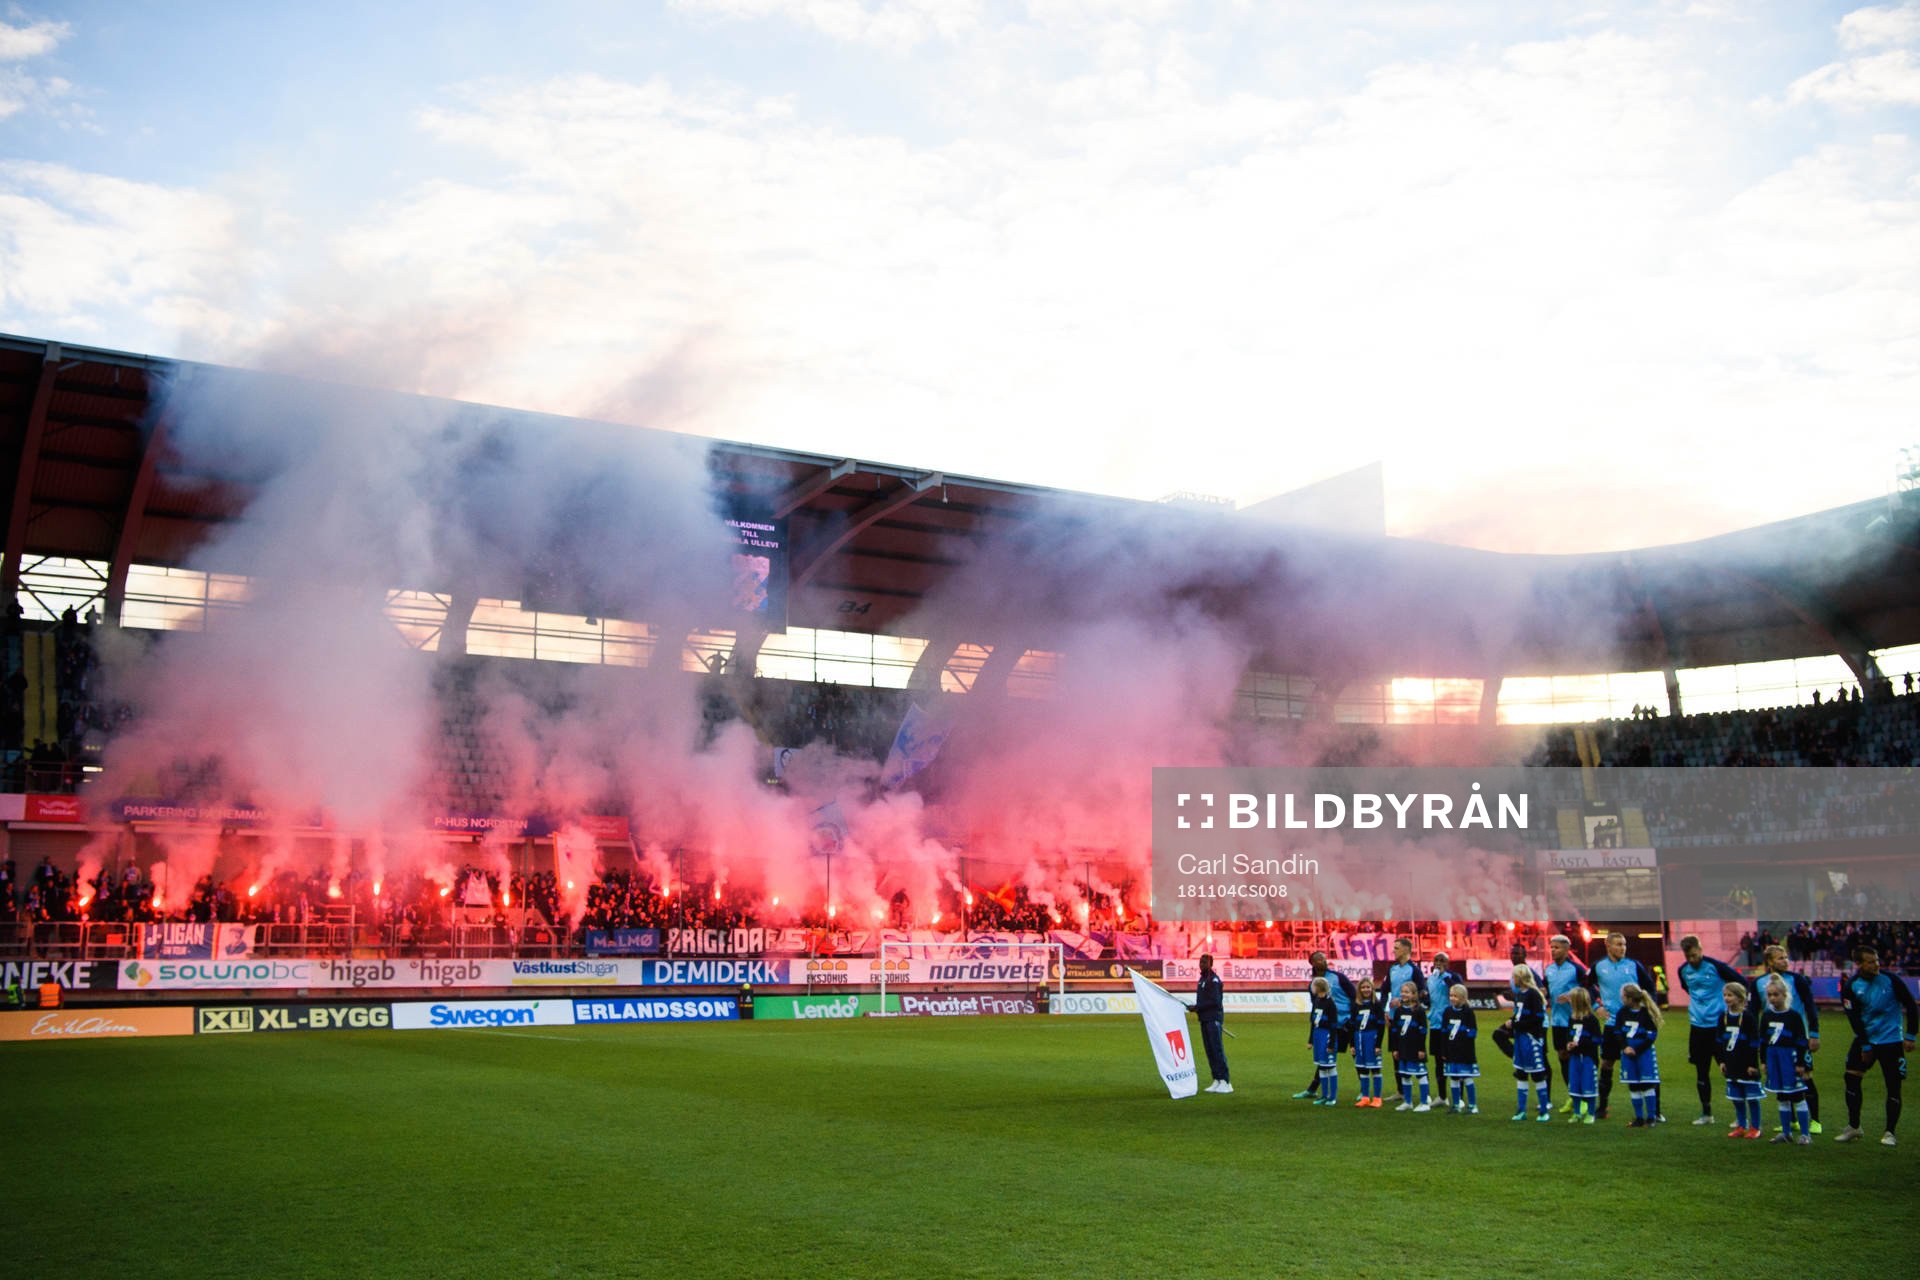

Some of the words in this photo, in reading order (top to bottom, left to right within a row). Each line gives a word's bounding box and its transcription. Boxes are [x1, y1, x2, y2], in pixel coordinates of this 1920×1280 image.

[724, 519, 775, 532] VÄLKOMMEN
[741, 529, 759, 538] TILL
[751, 540, 779, 549] ULLEVI
[124, 805, 195, 818] PARKERING
[435, 816, 468, 828] P-HUS
[1550, 857, 1590, 868] RASTA
[1602, 856, 1642, 867] RASTA
[147, 923, 205, 945] J-LIGAN
[330, 959, 395, 987] higab
[421, 959, 482, 986] higab
[655, 960, 780, 984] DEMIDEKK
[929, 961, 1045, 980] nordsvets
[1233, 964, 1272, 980] Botrygg
[576, 1002, 730, 1021] ERLANDSSON
[793, 999, 854, 1019] Lendo
[903, 996, 979, 1015] Prioritet
[981, 996, 1036, 1014] Finans
[258, 1007, 389, 1029] XL-BYGG
[430, 1004, 534, 1027] Swegon
[1358, 1009, 1371, 1030] 7
[1400, 1014, 1413, 1036] 7
[1449, 1019, 1462, 1041] 7
[1625, 1020, 1640, 1039] 7
[1725, 1026, 1741, 1051] 7
[1768, 1022, 1785, 1045] 7
[1804, 1052, 1813, 1064] 6
[1898, 1057, 1906, 1072] 2
